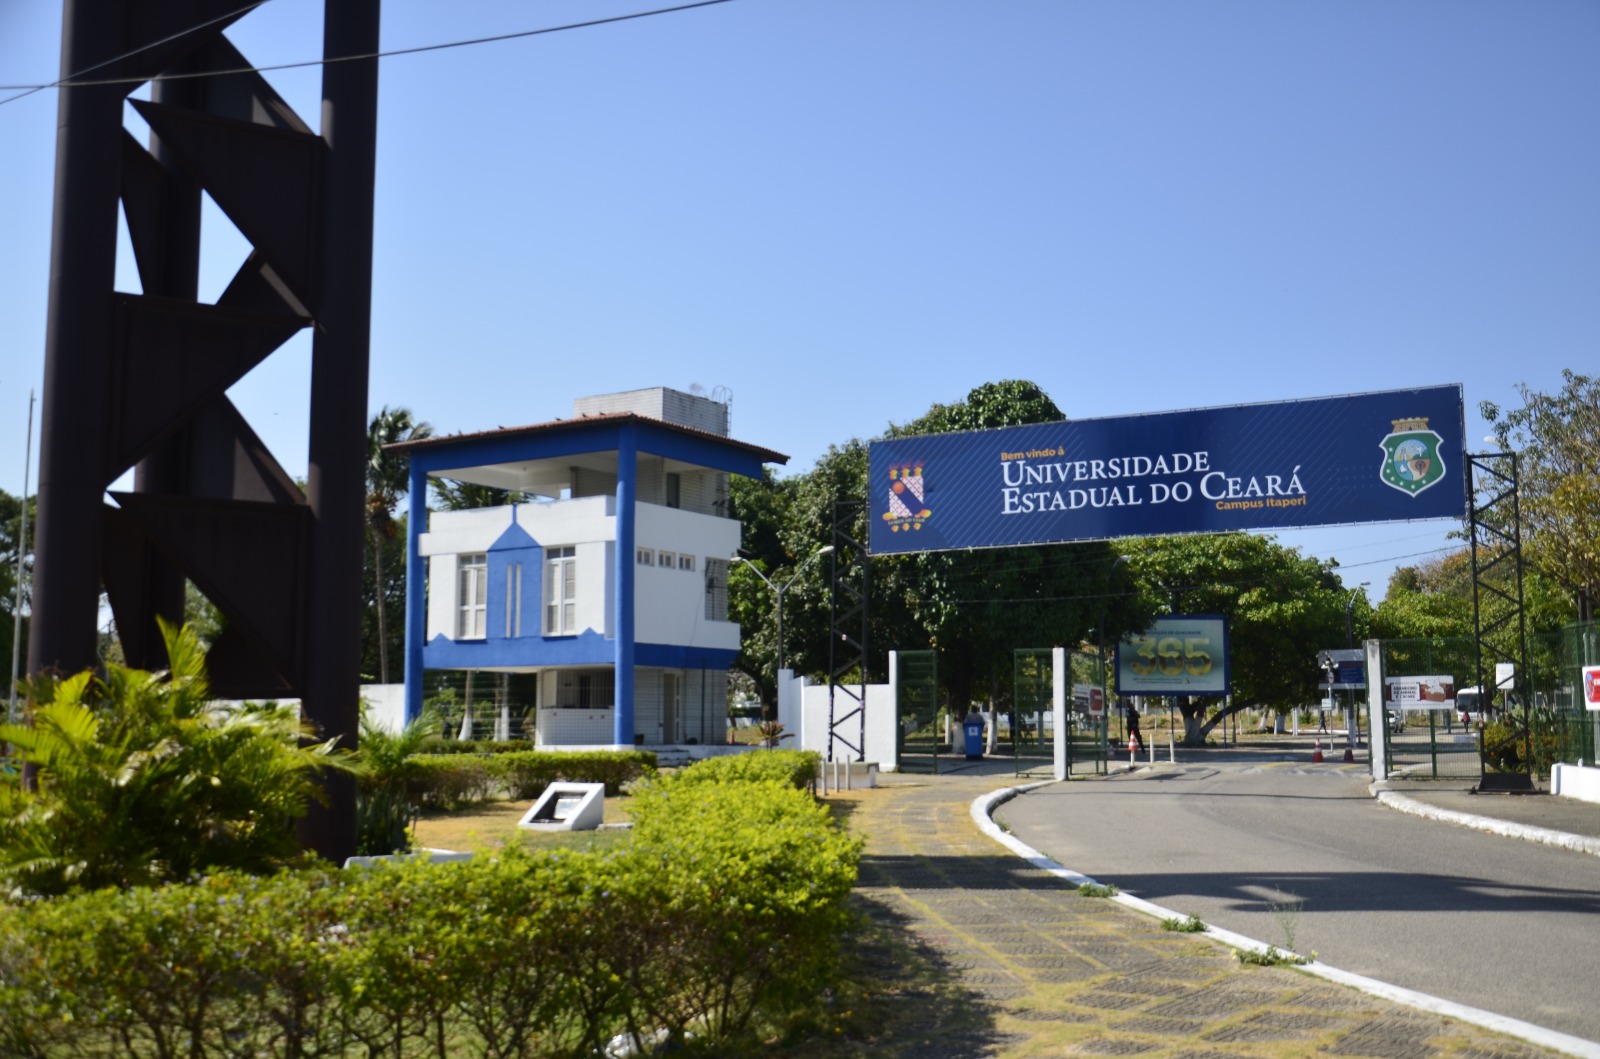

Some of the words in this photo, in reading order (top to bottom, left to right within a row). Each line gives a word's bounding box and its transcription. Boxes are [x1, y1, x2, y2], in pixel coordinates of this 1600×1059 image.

[1000, 451, 1210, 487] UNIVERSIDADE
[1001, 452, 1025, 461] Bem
[1026, 448, 1056, 458] vindo
[1001, 485, 1142, 515] ESTADUAL
[1149, 481, 1193, 504] DO
[1200, 464, 1307, 500] CEARÁ
[1215, 500, 1264, 510] Campus
[1266, 495, 1307, 508] Itaperi
[1130, 637, 1212, 676] 365
